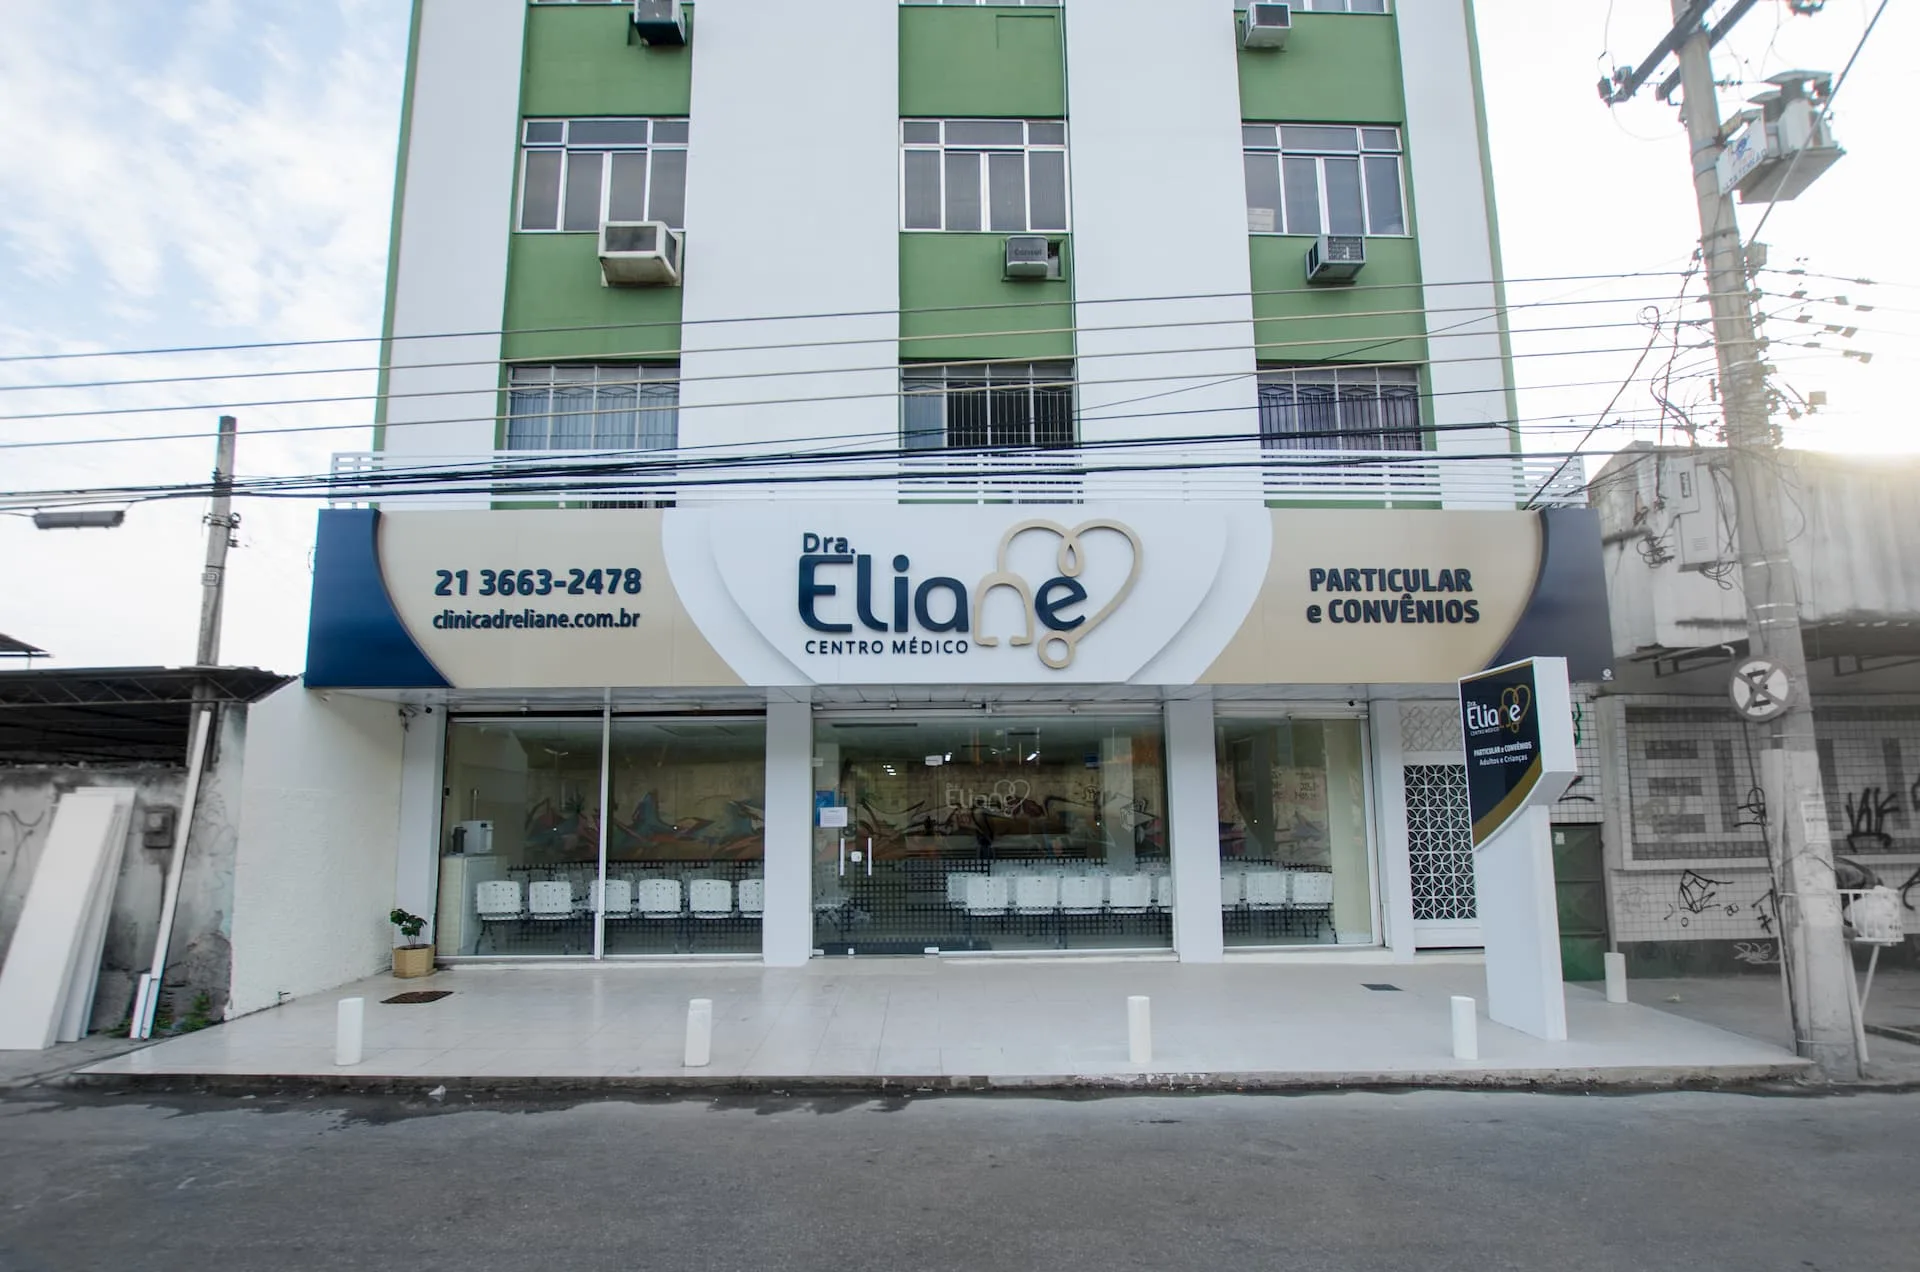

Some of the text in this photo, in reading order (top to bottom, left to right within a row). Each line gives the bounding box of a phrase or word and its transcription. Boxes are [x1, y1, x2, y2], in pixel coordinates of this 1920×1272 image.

[803, 532, 856, 555] Dra.
[434, 568, 642, 596] 21 3663-2478
[1309, 568, 1473, 593] PARTICULAR
[798, 554, 1088, 647] Eliane
[1306, 593, 1480, 624] e CONVÊNIOS
[433, 608, 641, 629] clinicadreliane.com.br
[805, 636, 969, 655] CENTRO MÉDICO
[1467, 704, 1521, 730] Eliane
[1473, 746, 1501, 756] PARTICULAR
[1504, 741, 1532, 752] CONVÊNIOS
[1479, 757, 1500, 766] Adultos
[1504, 754, 1528, 764] Crianças
